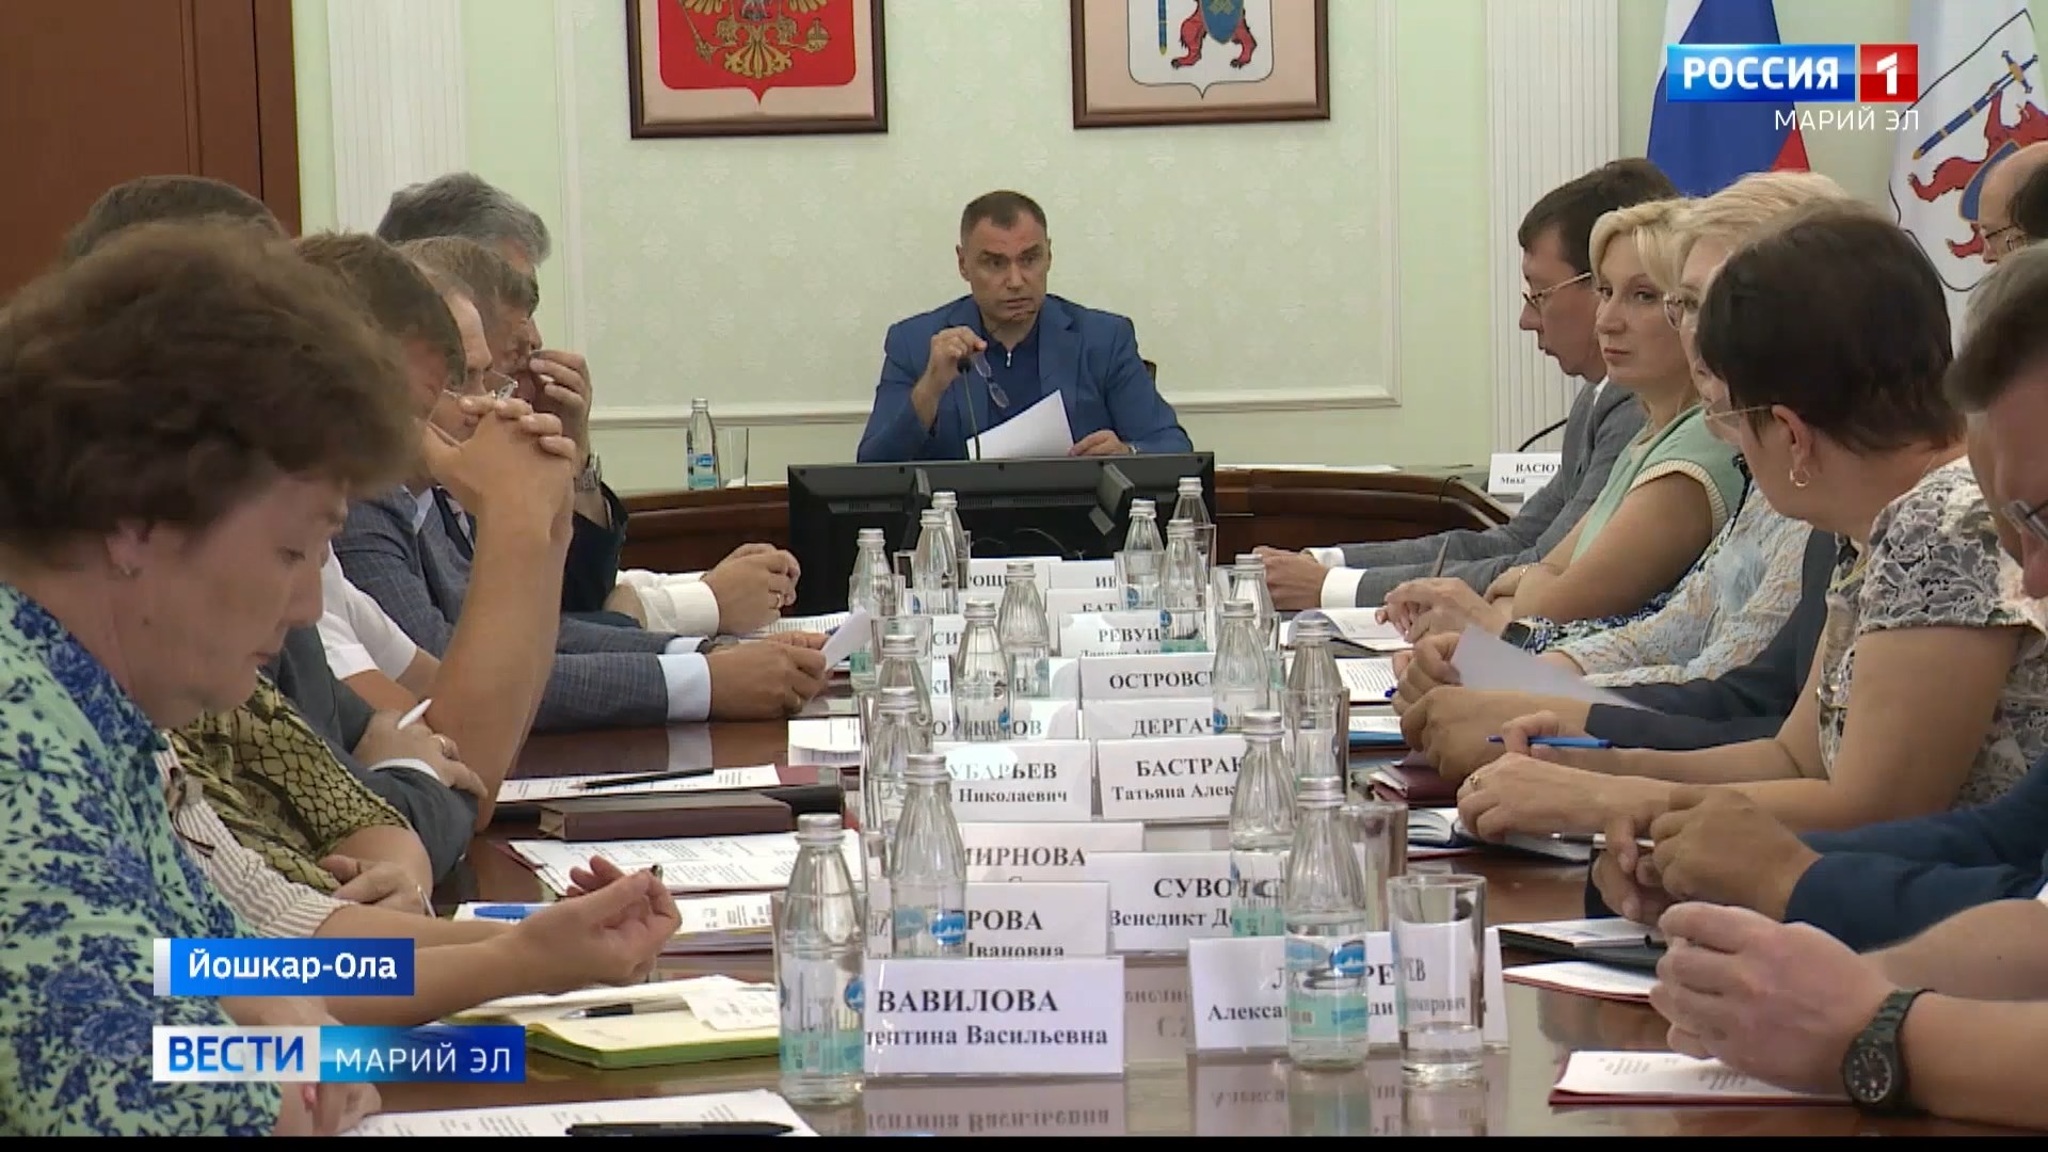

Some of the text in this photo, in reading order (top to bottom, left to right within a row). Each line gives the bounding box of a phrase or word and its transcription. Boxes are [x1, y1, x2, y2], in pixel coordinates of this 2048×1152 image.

[1515, 463, 1562, 474] ВАСЮ
[949, 762, 1058, 780] УБАРЬЕВ
[959, 788, 1068, 803] Николаевич
[1111, 783, 1236, 801] Татьяна Алек
[966, 909, 1043, 931] РОВА
[1110, 909, 1207, 928] Венедикт
[877, 988, 1059, 1013] ВАВИЛОВА
[1208, 1004, 1286, 1021] Алекса
[967, 1024, 1108, 1046] Васильевна
